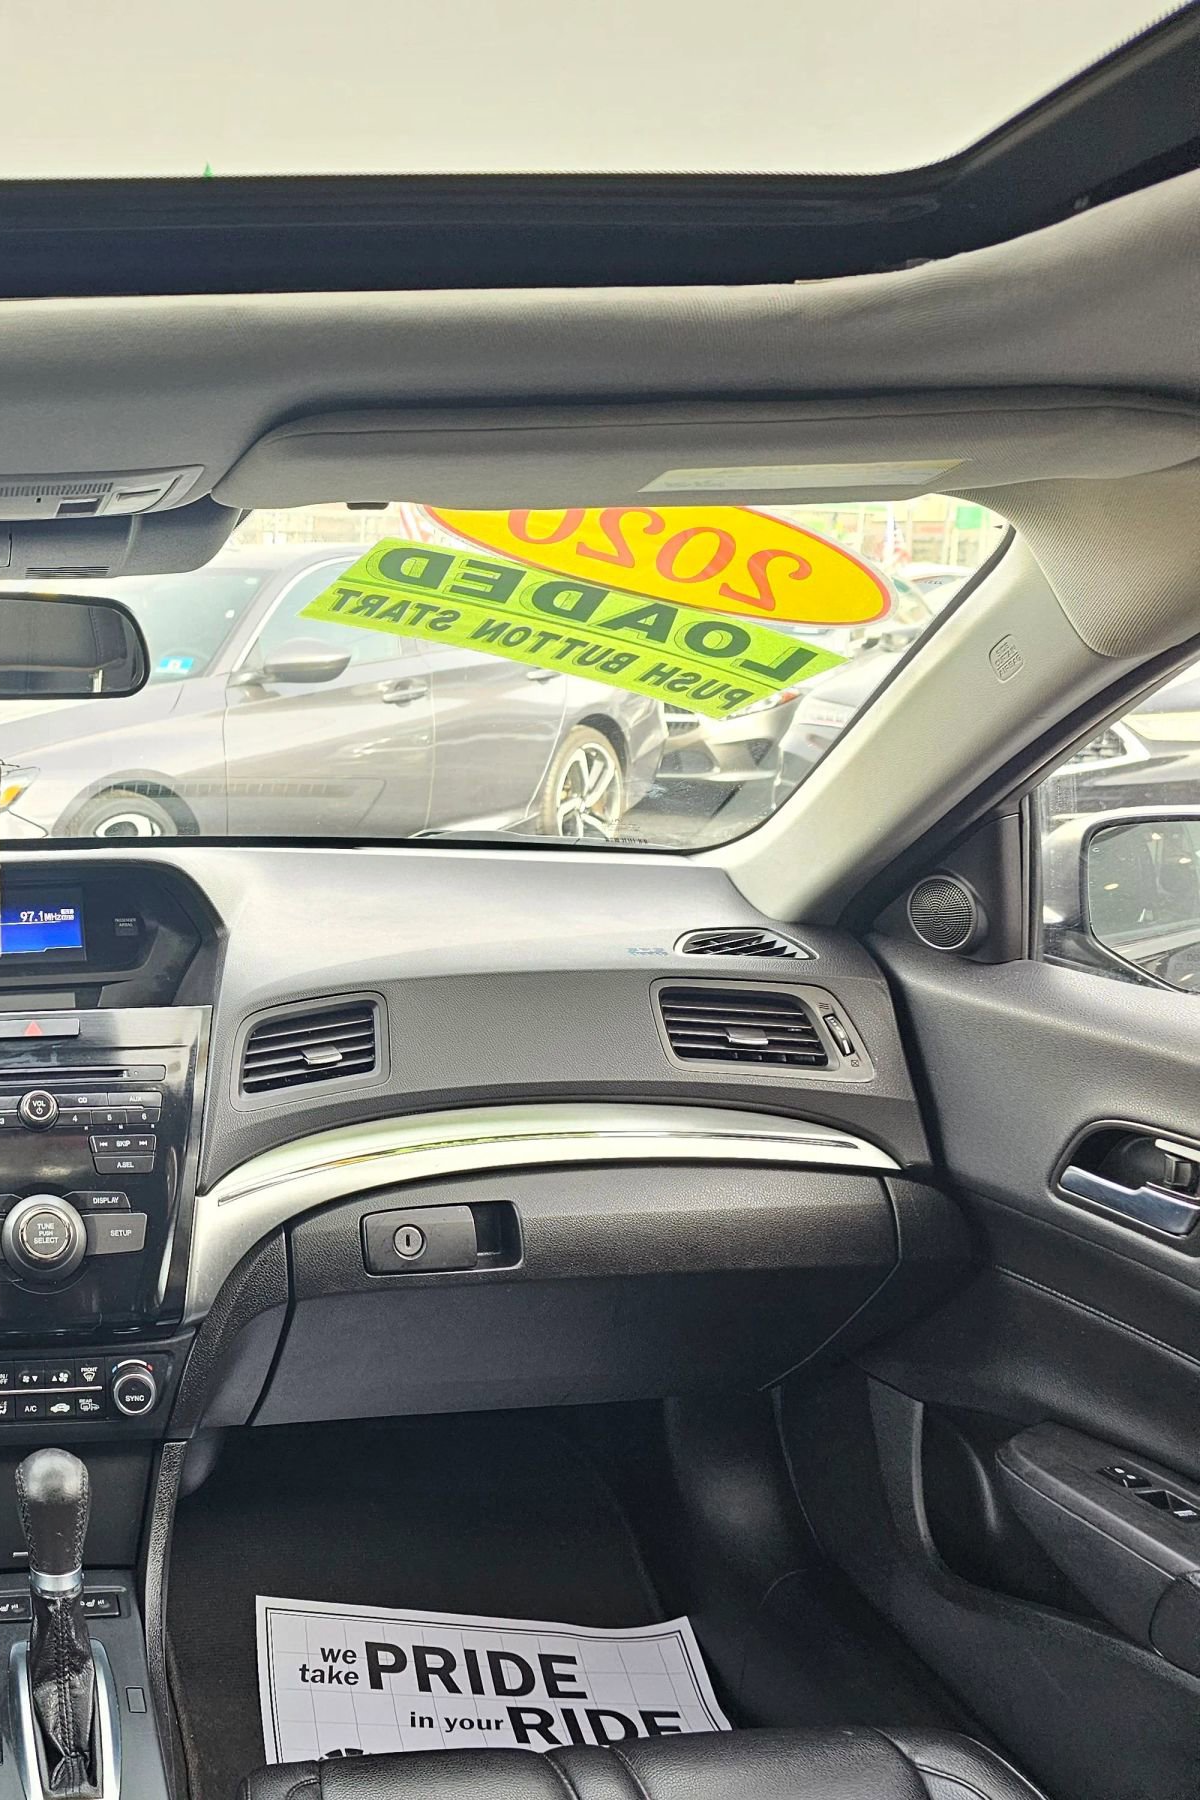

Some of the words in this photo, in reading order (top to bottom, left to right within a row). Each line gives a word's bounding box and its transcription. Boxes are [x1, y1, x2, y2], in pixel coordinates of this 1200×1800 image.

[32, 1100, 46, 1108] VOL
[92, 1196, 120, 1205] DISPLAY
[37, 1222, 55, 1230] TUNE
[110, 1229, 132, 1237] SETUP
[125, 1394, 145, 1403] SYNC
[24, 1405, 38, 1413] A/C
[320, 1648, 357, 1665] we
[364, 1640, 589, 1699] PRIDE
[299, 1663, 360, 1687] take
[410, 1710, 434, 1730] in
[444, 1716, 504, 1734] your
[506, 1705, 681, 1746] RIDE
